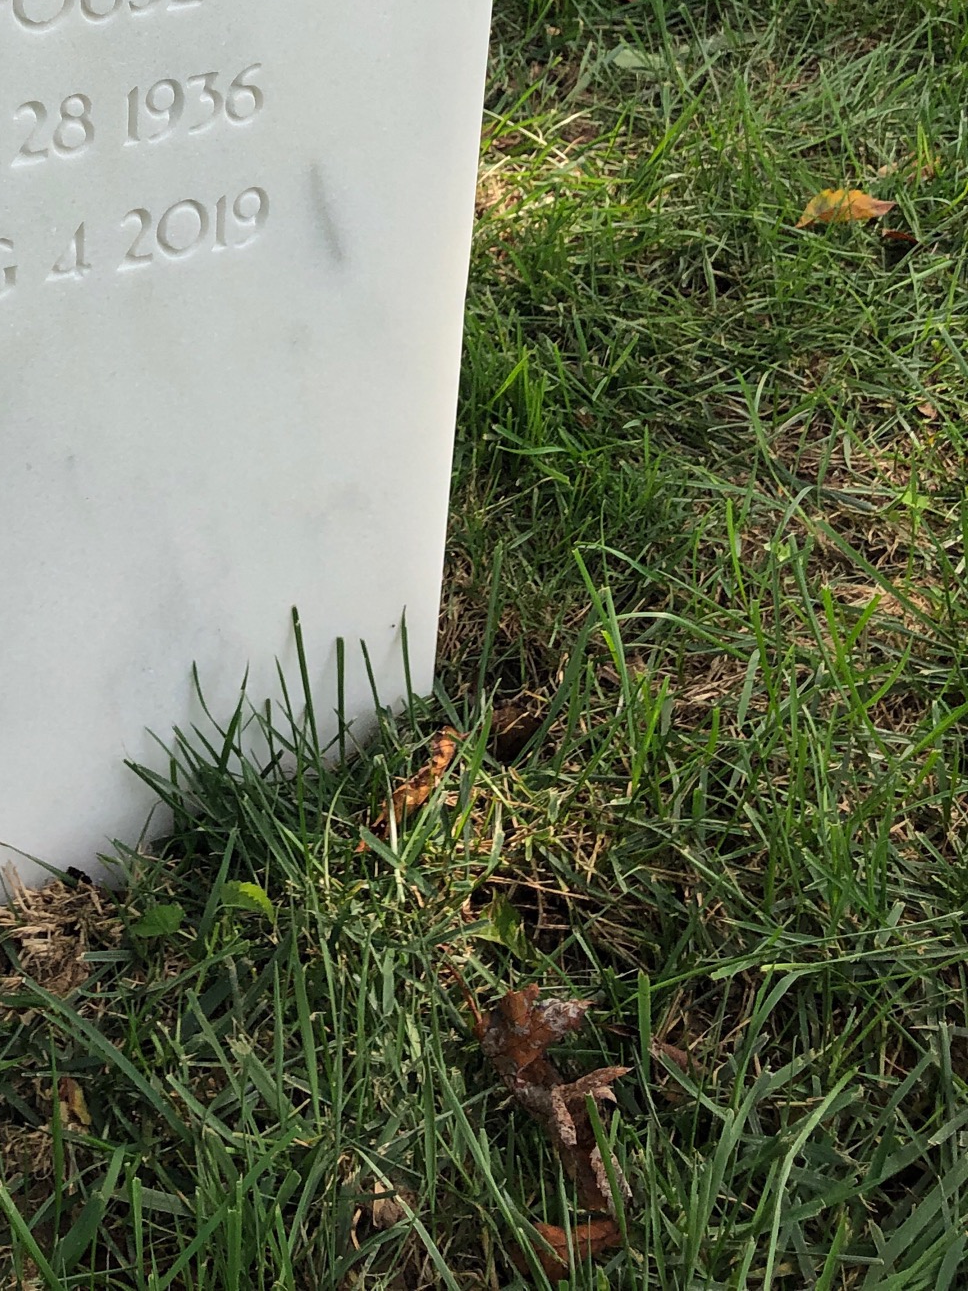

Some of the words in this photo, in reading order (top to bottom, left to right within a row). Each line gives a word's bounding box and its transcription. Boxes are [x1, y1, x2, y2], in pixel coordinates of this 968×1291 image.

[11, 93, 96, 168] 28
[122, 63, 265, 147] 1936
[44, 221, 93, 282] 4
[116, 186, 270, 272] 2019
